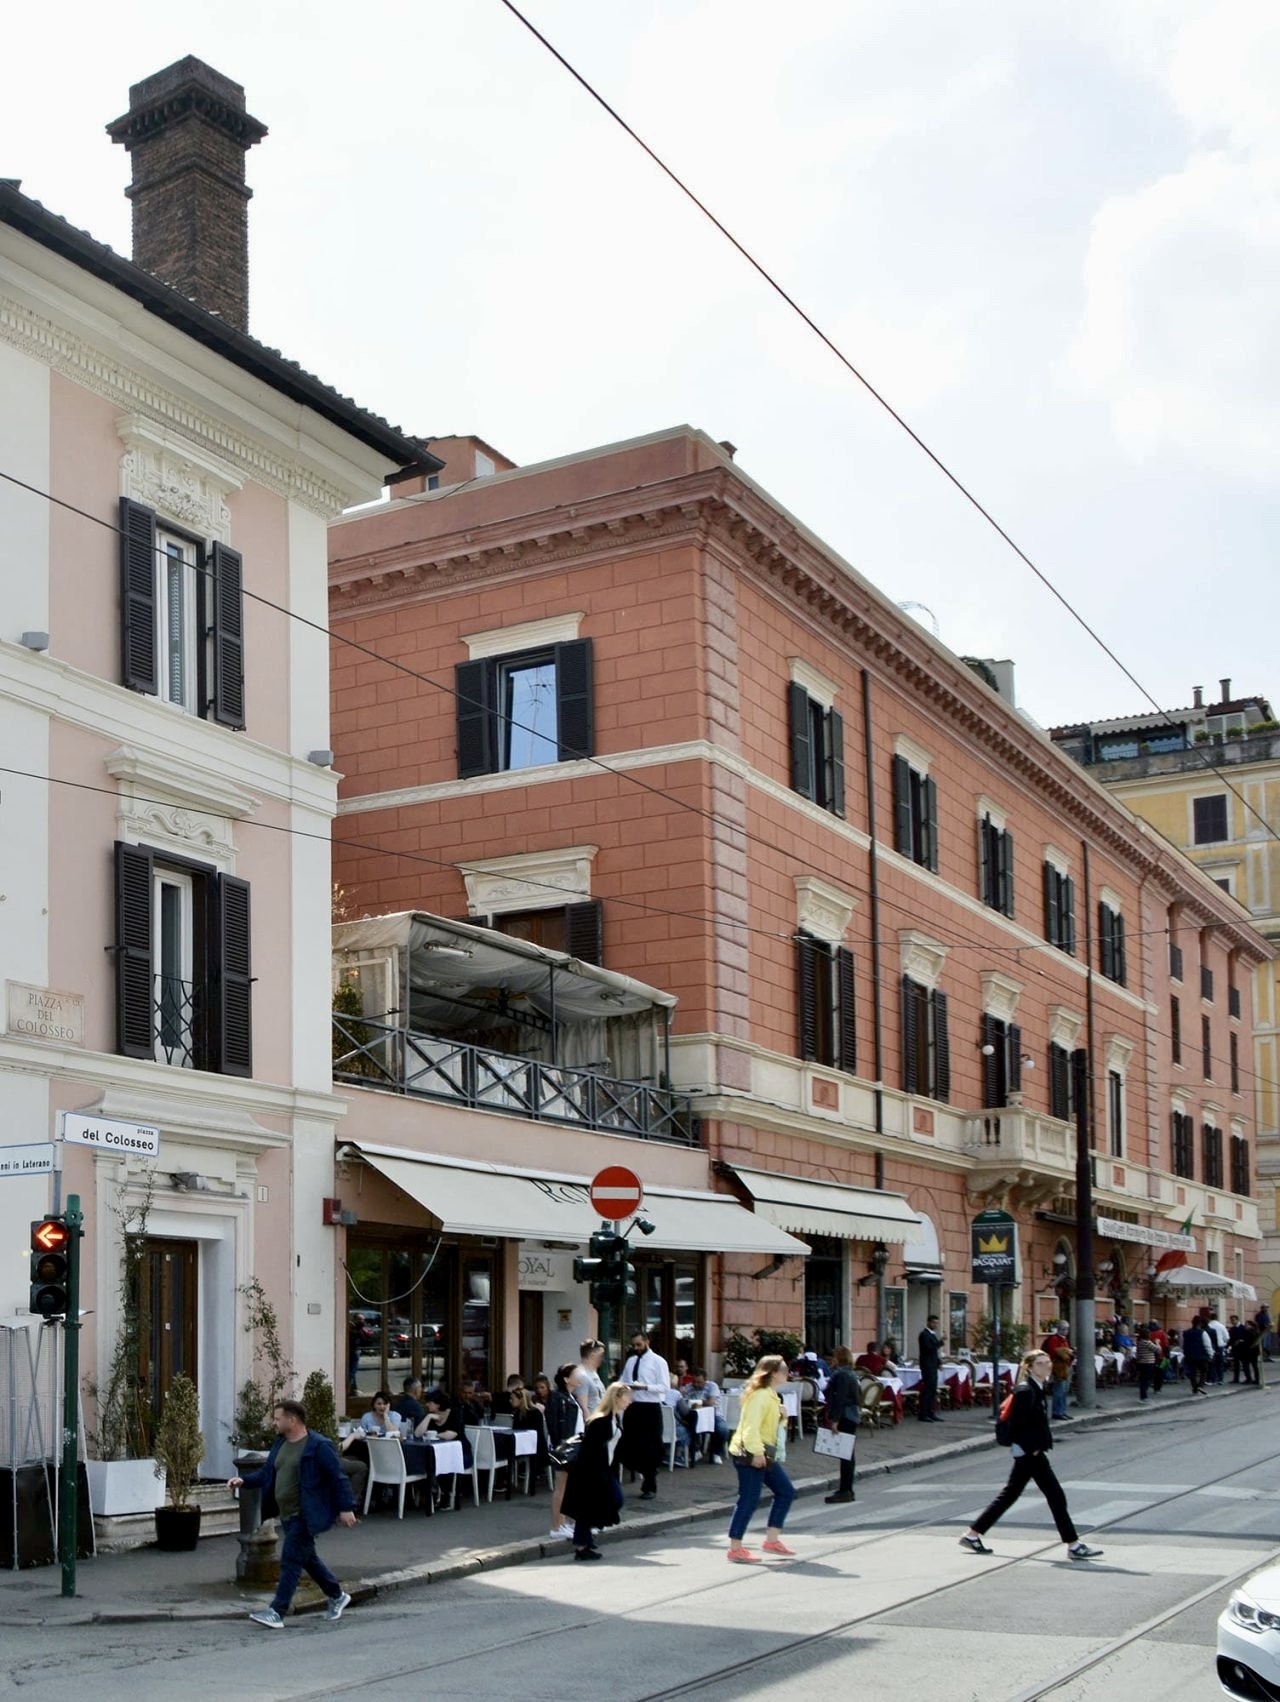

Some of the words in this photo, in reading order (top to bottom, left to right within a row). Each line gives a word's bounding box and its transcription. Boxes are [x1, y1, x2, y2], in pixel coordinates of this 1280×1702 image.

[28, 993, 62, 1010] PIAZZA
[37, 1009, 54, 1022] DEL
[82, 1128, 100, 1141] del
[105, 1132, 154, 1151] Colosseo
[136, 1128, 154, 1136] piazza
[13, 1160, 20, 1170] in
[22, 1159, 51, 1170] Laterano
[517, 1256, 556, 1278] OYAL
